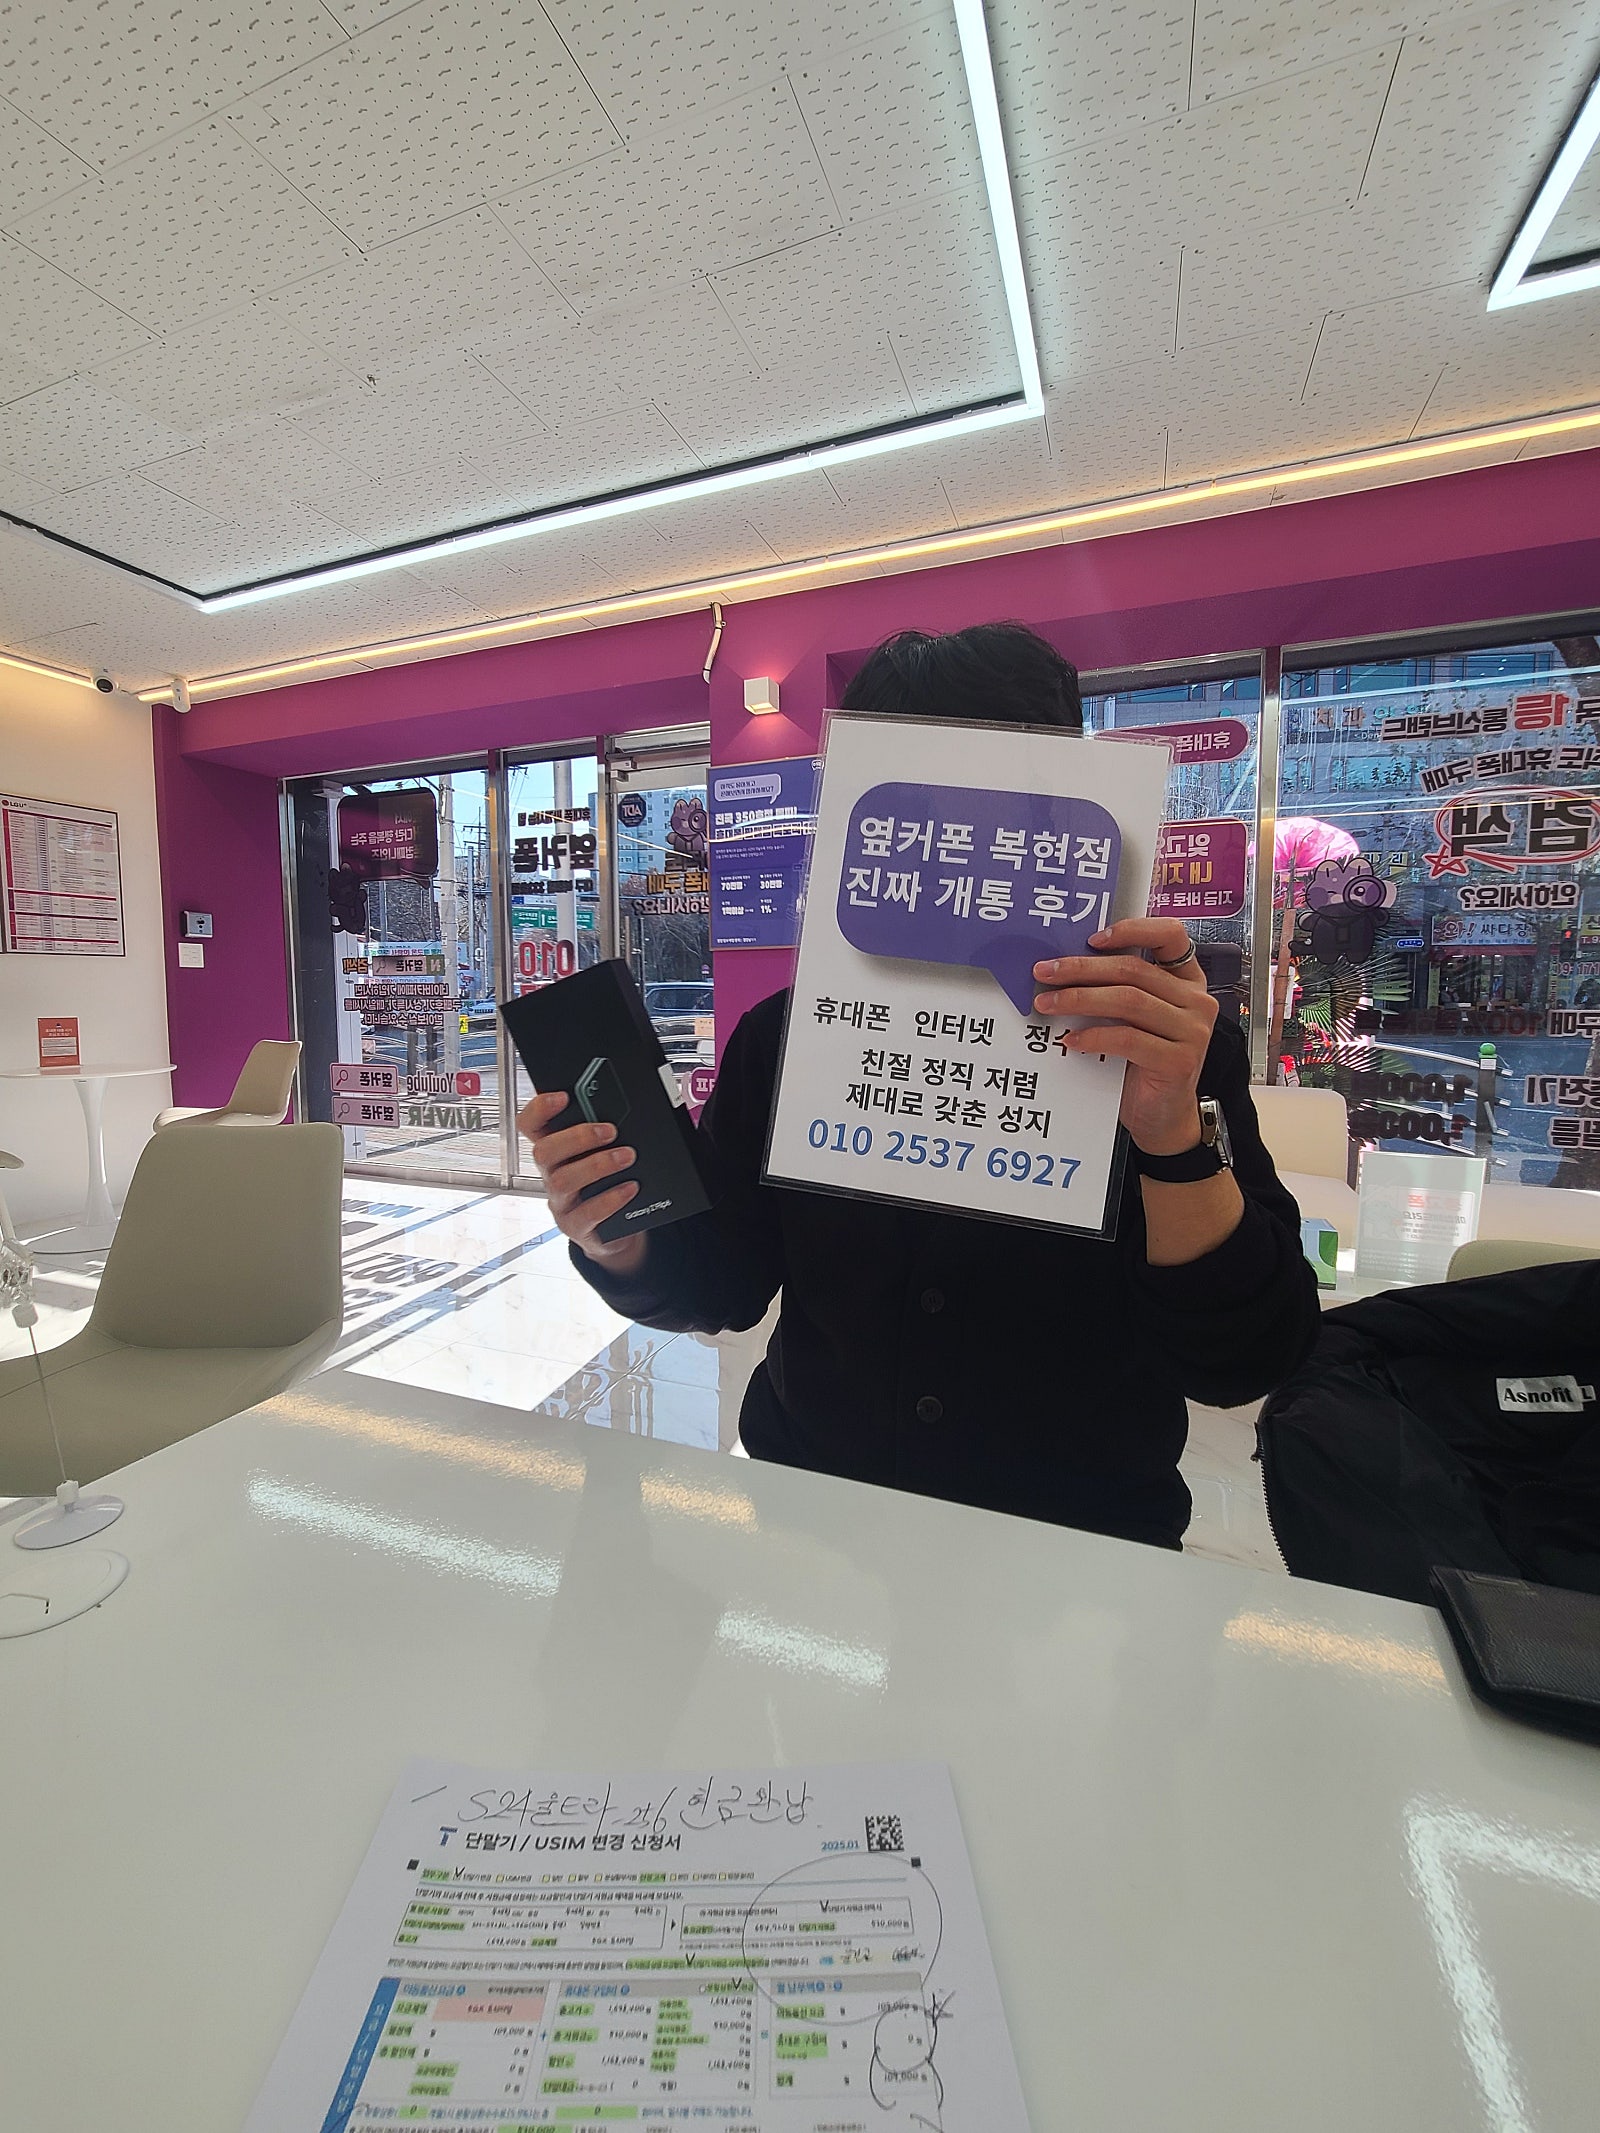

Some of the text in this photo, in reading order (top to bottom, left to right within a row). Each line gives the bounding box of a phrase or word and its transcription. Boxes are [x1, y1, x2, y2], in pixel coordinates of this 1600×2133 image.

[860, 815, 1111, 880] 옆커폰 복현점
[846, 864, 1110, 933] 진짜 개통 후기
[813, 996, 1107, 1062] 휴대폰 인터넷 정수
[861, 1048, 1039, 1101] 친절 정직 저렴
[845, 1082, 1053, 1139] 제대로 갖춘 성지
[807, 1118, 1082, 1190] 010 2537 6927
[1503, 1387, 1593, 1404] Asnofit L
[465, 1832, 516, 1851] 단말기
[535, 1835, 586, 1850] USIM
[591, 1832, 625, 1851] 변경
[631, 1832, 682, 1852] 신청서
[821, 1839, 859, 1852] 2025.01
